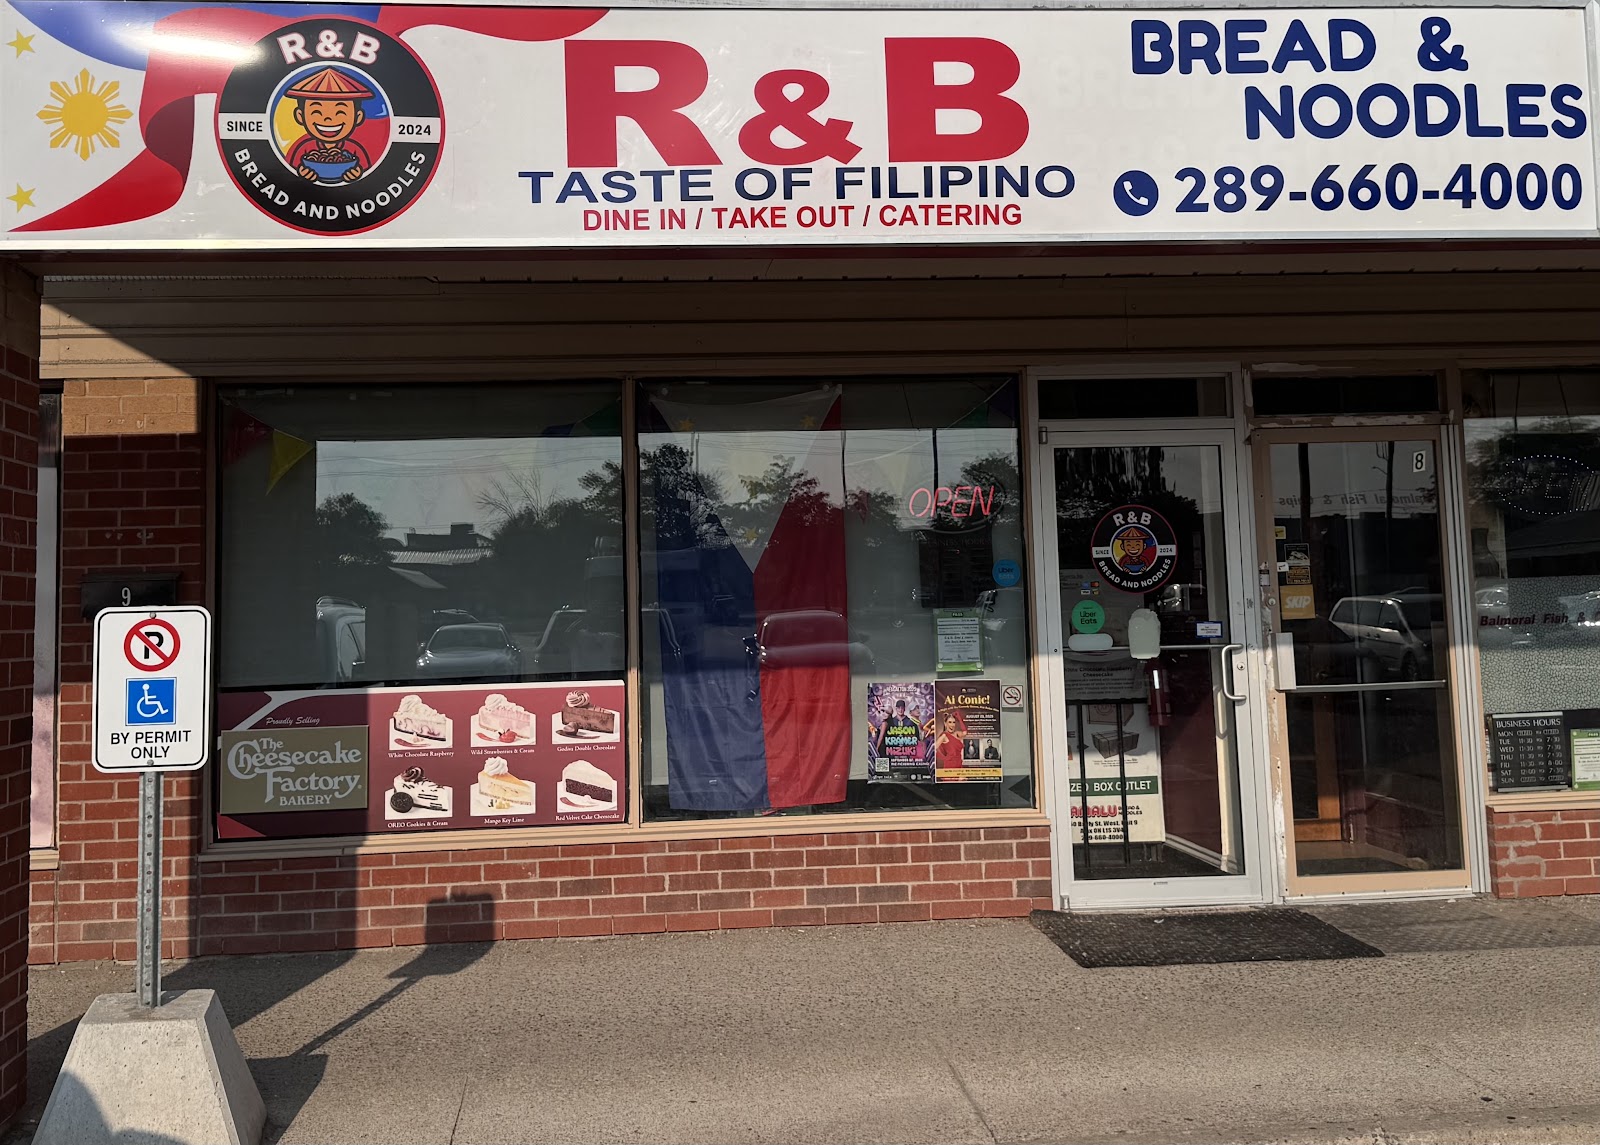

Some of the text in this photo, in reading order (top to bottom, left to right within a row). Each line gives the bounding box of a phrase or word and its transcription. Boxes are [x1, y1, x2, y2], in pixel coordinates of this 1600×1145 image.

[276, 29, 381, 65] R&B
[1130, 16, 1469, 75] BREAD &
[1244, 83, 1587, 140] NOODLES
[227, 121, 263, 132] SINCE
[398, 124, 431, 136] 2024
[234, 148, 426, 220] BREAD AND NOODLES
[518, 165, 1076, 204] TASTE OF FILIPINO
[1174, 162, 1582, 214] 289-660-4000
[583, 204, 1022, 230] DINE IN / TAKE OUT / CATERING
[1415, 452, 1424, 470] 8
[909, 486, 994, 517] OPEN
[1099, 560, 1120, 583] BREAD
[1122, 580, 1139, 588] AND
[1141, 558, 1171, 587] NOODLES
[121, 587, 131, 606] 9
[1286, 596, 1311, 608] SKIP
[1480, 614, 1535, 626] Balmoral
[1544, 613, 1569, 624] Fish
[1577, 612, 1586, 622] &
[958, 695, 990, 705] Conic!
[266, 717, 320, 726] Proudly Selling
[1496, 718, 1561, 728] BUSINESS HOURS
[110, 730, 192, 745] BY PERMIT
[887, 726, 916, 735] JASON
[259, 738, 284, 750] The
[885, 737, 918, 746] KRAMER
[131, 745, 170, 759] ONLY
[227, 740, 362, 779] Cheesecake
[254, 766, 361, 804] Factory
[1094, 782, 1113, 791] BOX
[280, 794, 333, 806] BAKERY
